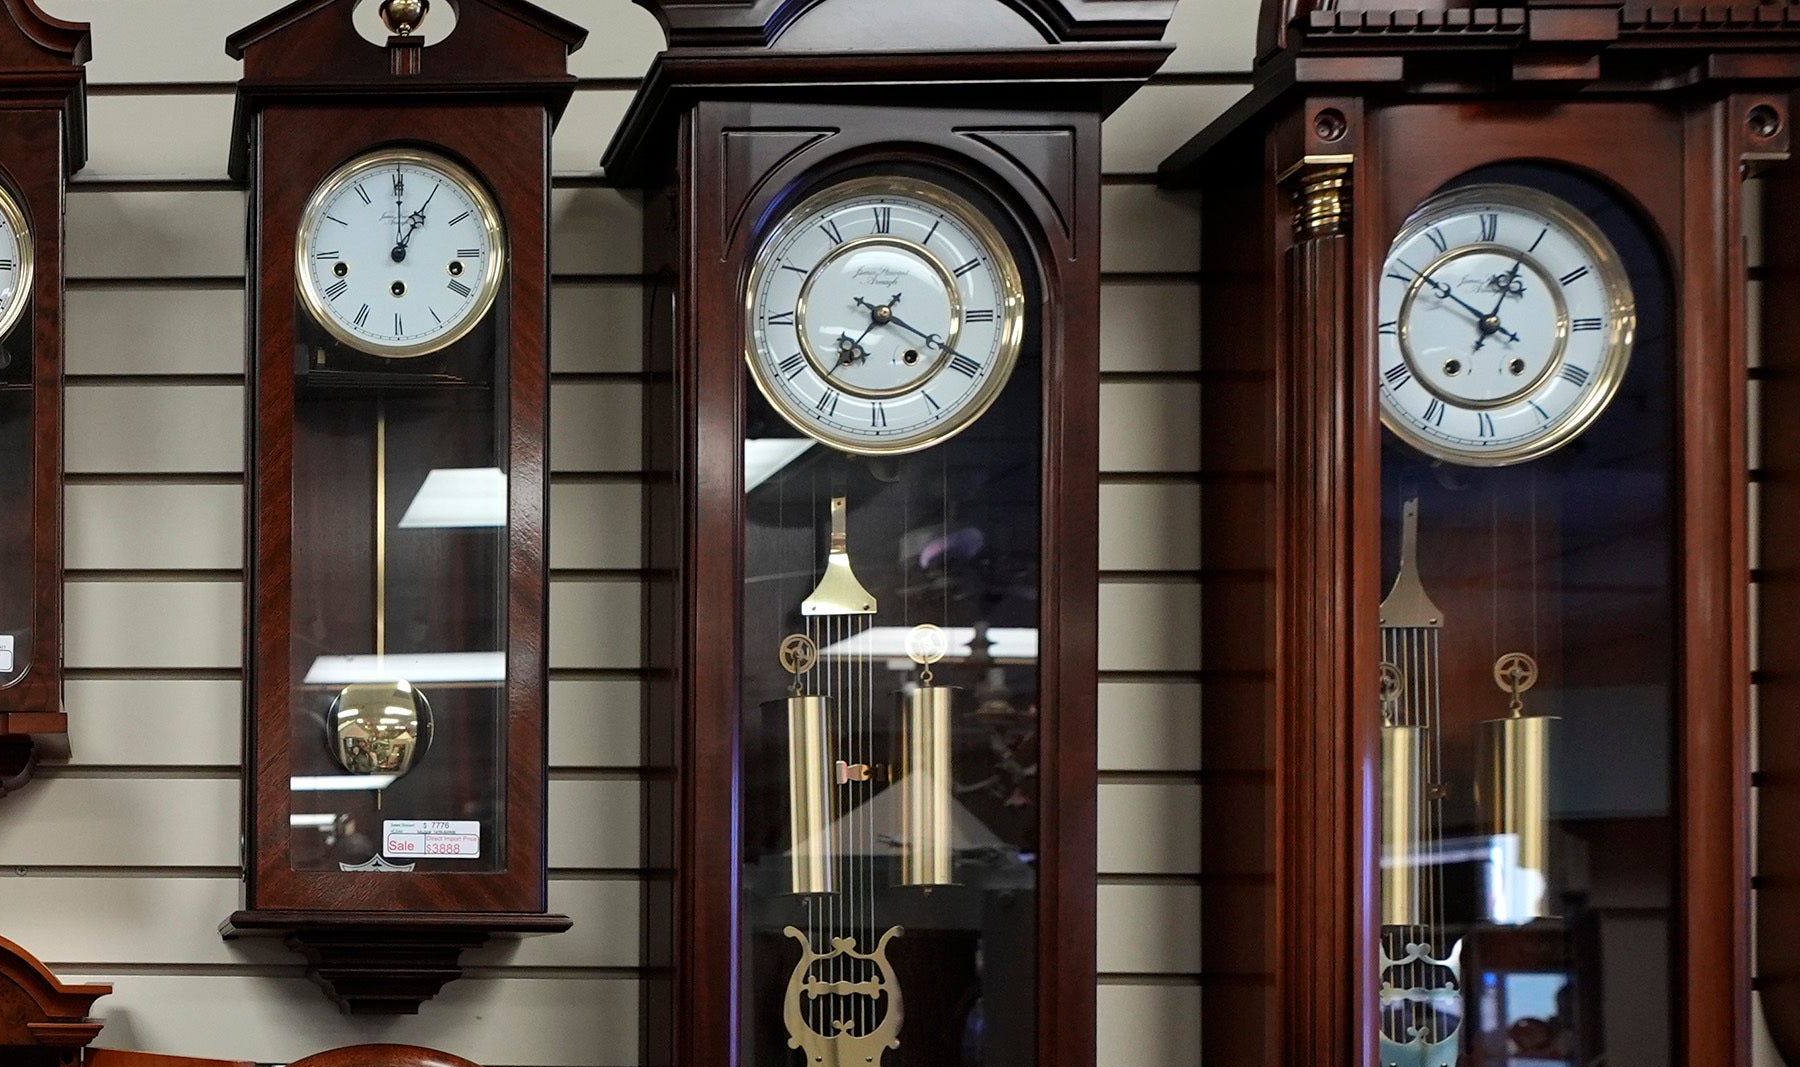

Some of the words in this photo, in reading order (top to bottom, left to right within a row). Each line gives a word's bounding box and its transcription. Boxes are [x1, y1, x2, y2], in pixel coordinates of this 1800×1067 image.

[871, 207, 890, 234] XII
[819, 219, 844, 250] XI
[457, 249, 480, 258] III
[953, 257, 981, 277] II
[1560, 266, 1588, 286] II
[768, 311, 794, 325] IX
[966, 309, 993, 323] III
[1573, 318, 1601, 332] III
[779, 352, 808, 381] VIII
[816, 387, 840, 417] VII
[921, 390, 941, 415] V
[871, 401, 887, 427] VI
[389, 840, 414, 851] Sale
[426, 844, 460, 854] $3888
